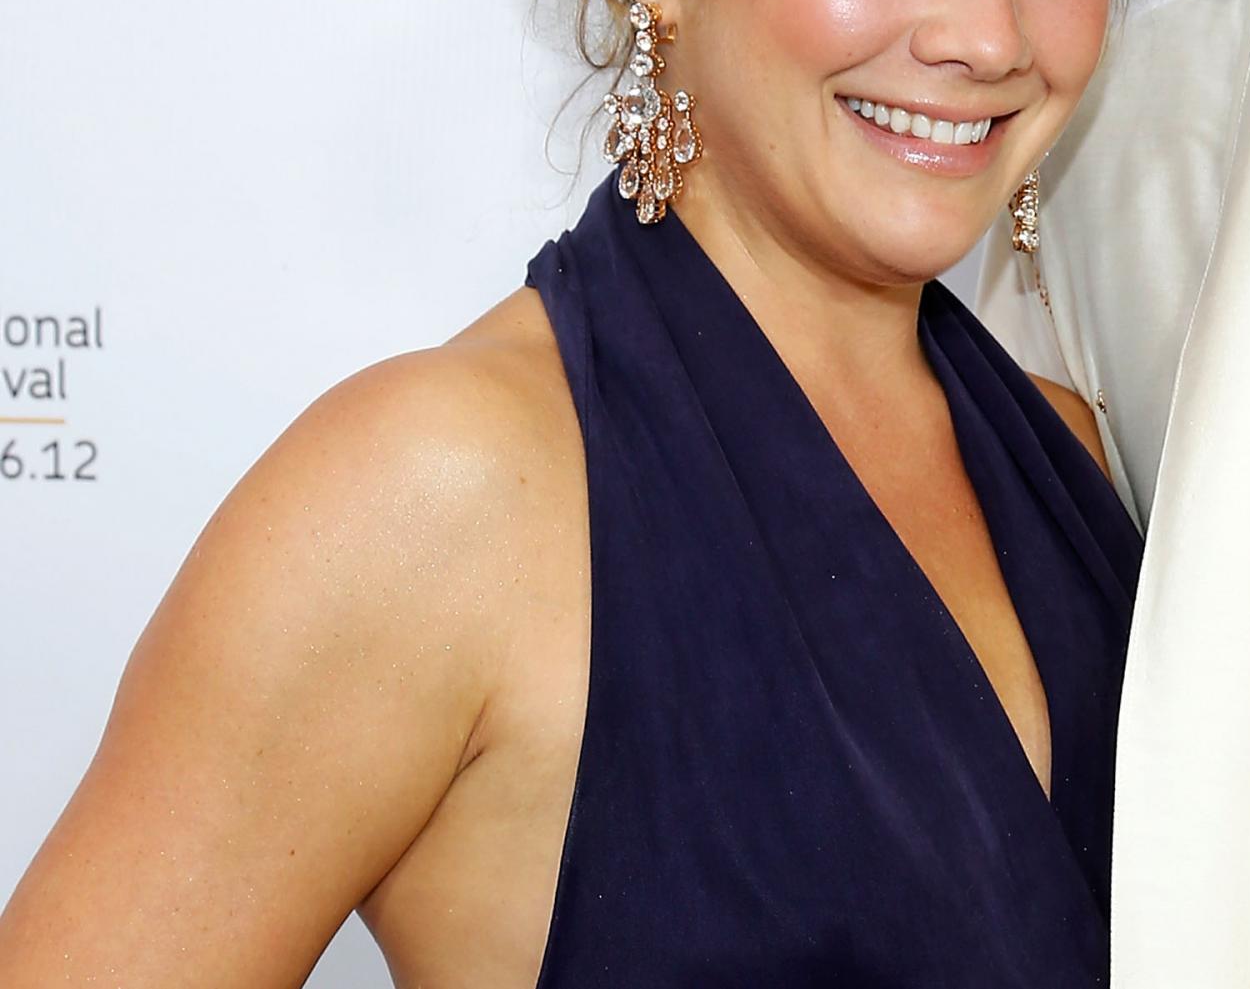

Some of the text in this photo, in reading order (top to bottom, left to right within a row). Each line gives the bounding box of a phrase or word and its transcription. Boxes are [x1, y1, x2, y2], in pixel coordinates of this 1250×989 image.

[3, 307, 103, 348] onal
[3, 358, 66, 400] val
[0, 439, 98, 481] 6.12
